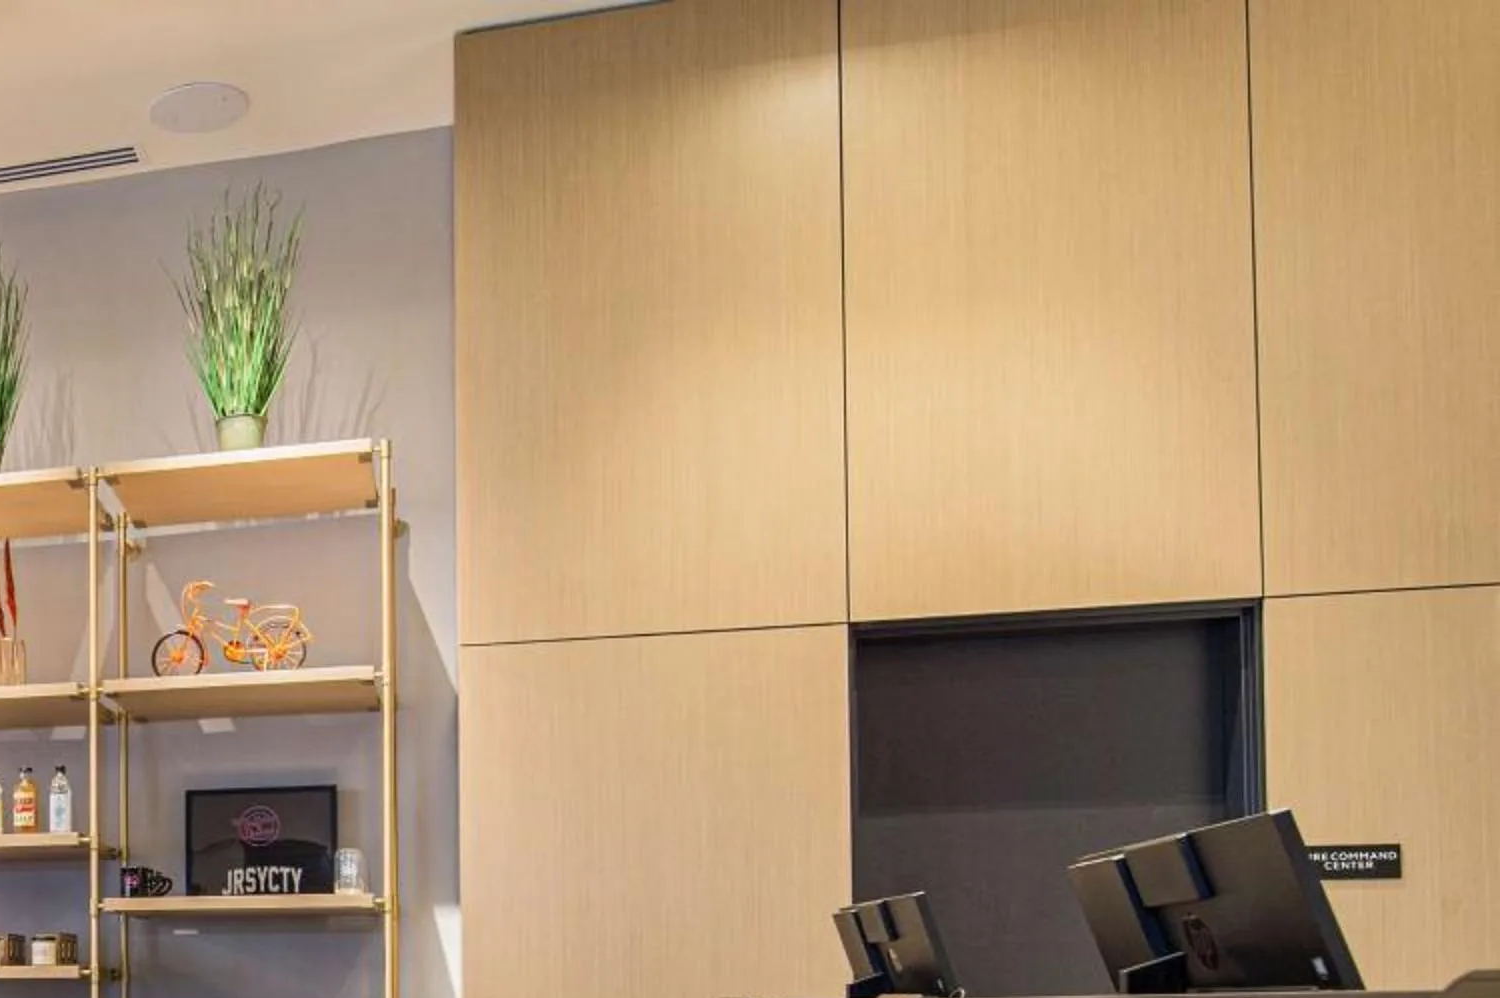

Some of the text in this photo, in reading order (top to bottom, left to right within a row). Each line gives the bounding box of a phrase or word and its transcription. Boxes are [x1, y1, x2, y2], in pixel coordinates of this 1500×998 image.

[1330, 851, 1397, 861] COMMAND
[1323, 861, 1374, 871] CENTER
[221, 865, 303, 895] JRSYCTY
